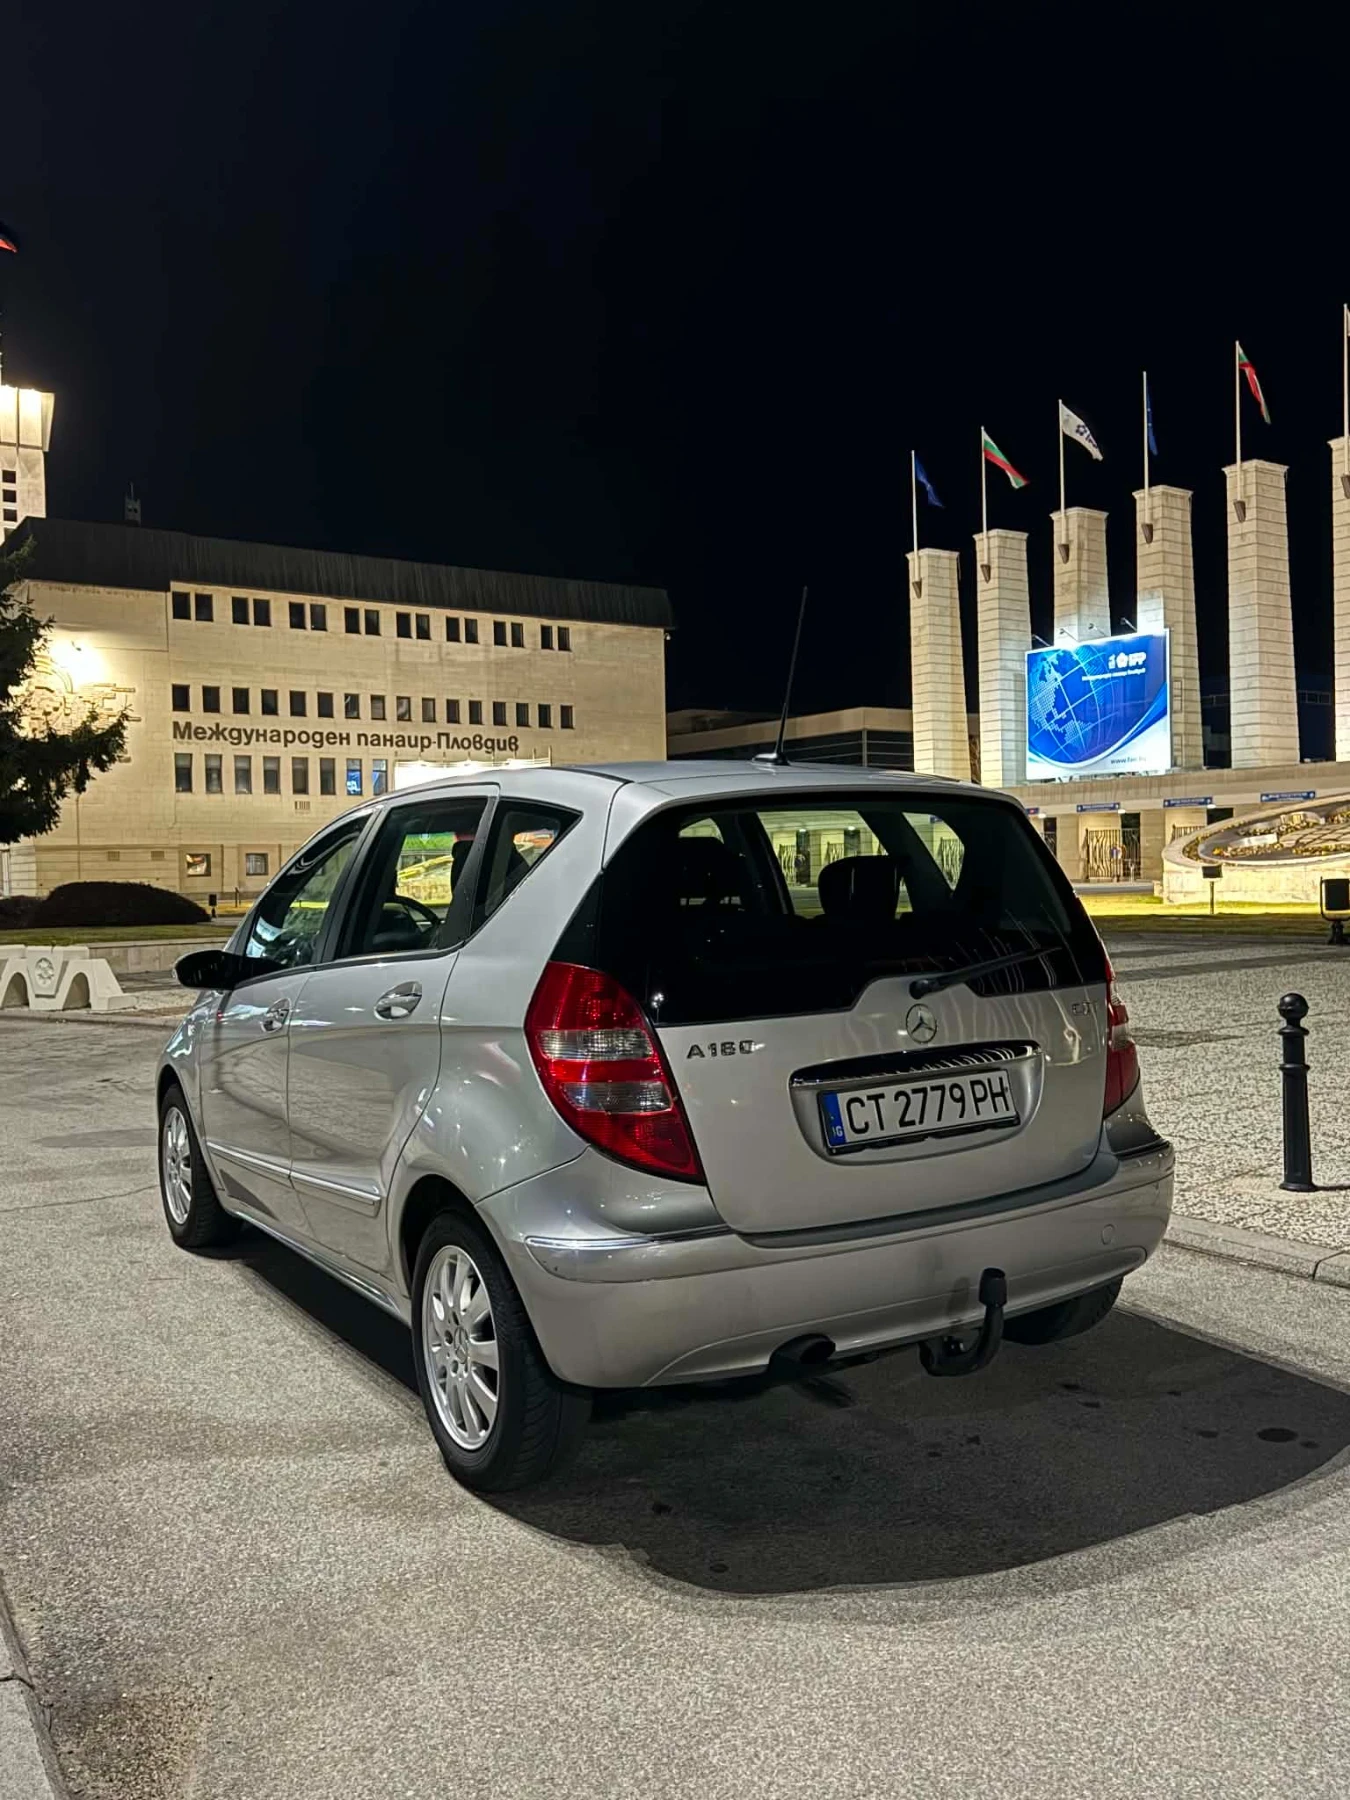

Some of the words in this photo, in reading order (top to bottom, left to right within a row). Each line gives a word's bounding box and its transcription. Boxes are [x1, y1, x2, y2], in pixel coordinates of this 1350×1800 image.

[172, 720, 351, 749] Международен
[845, 1093, 887, 1135] CT
[893, 1080, 966, 1129] 2779
[968, 1075, 1011, 1117] PH
